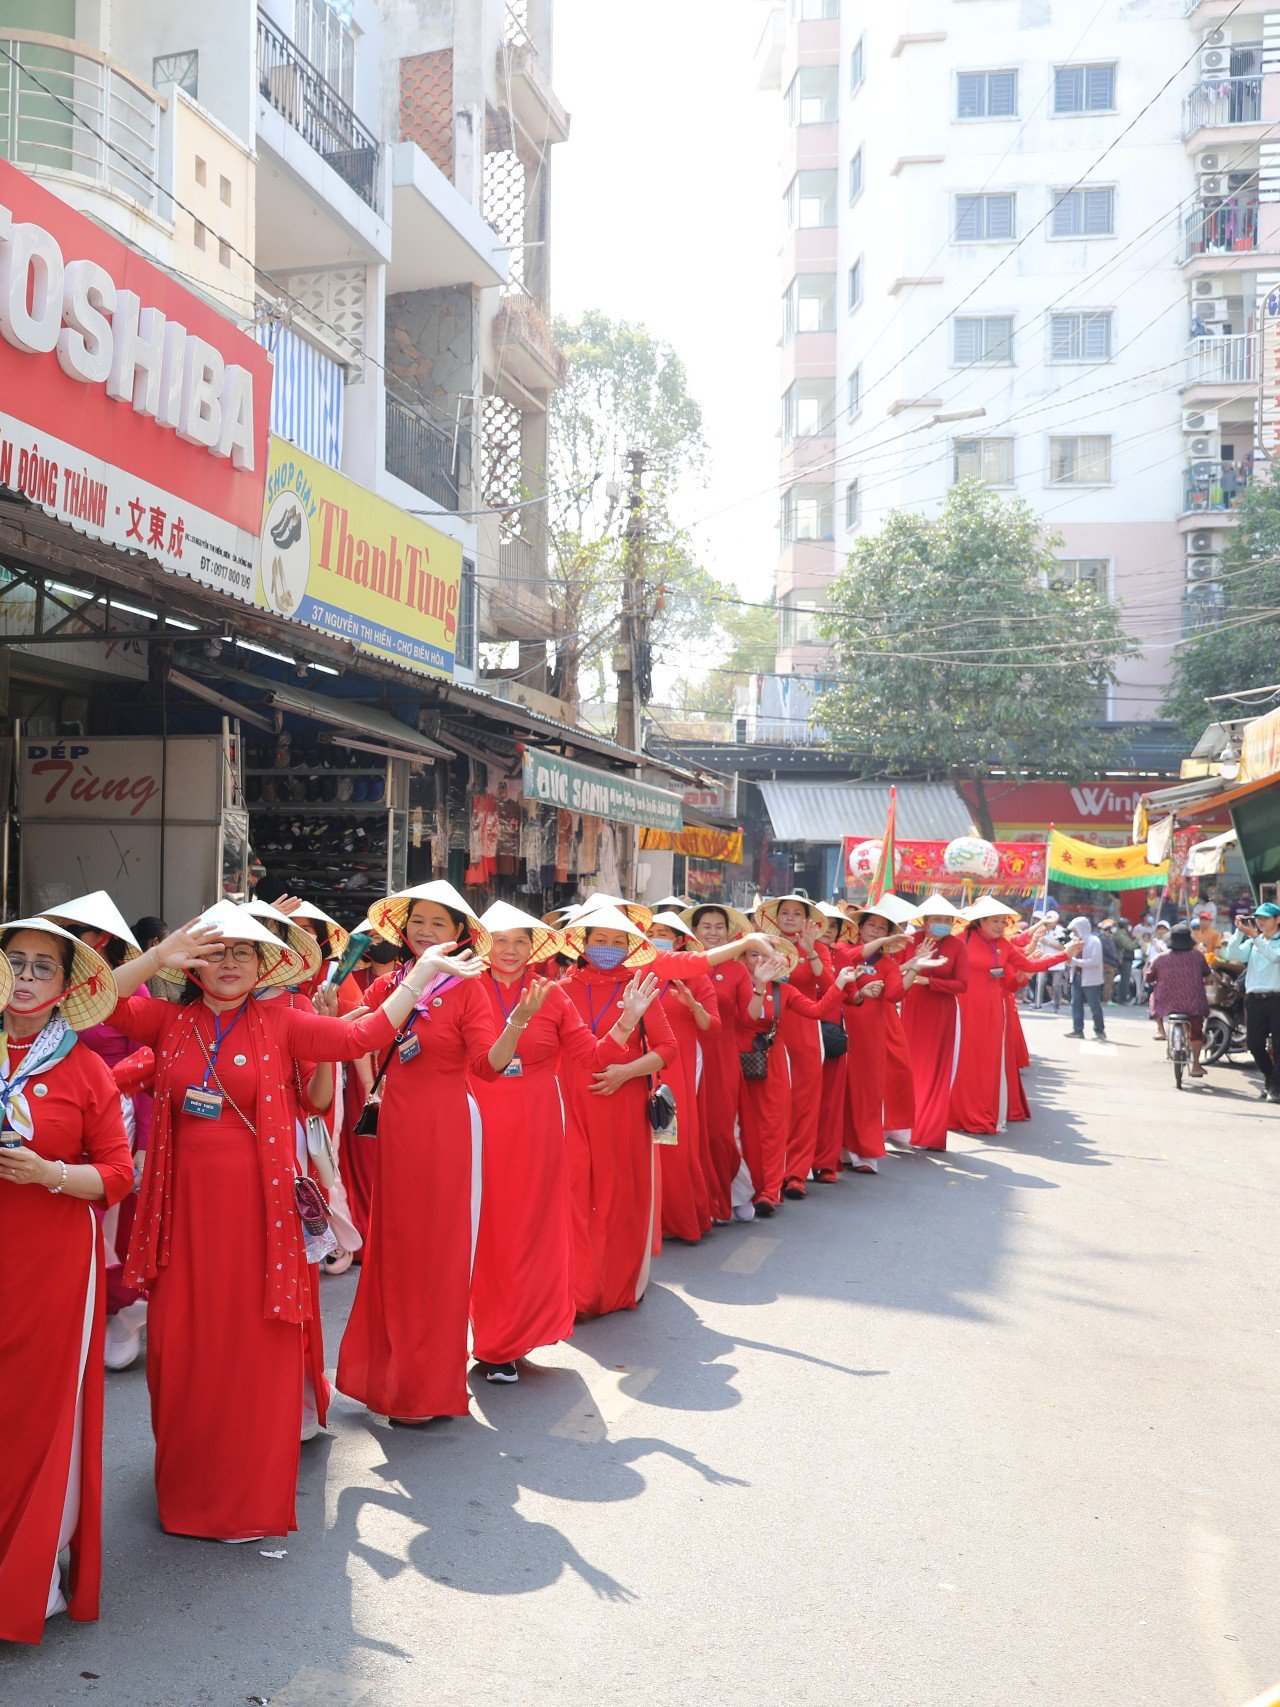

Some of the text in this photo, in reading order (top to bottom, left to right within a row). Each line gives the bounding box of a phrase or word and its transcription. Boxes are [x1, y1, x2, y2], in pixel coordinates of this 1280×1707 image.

[18, 444, 58, 508] ĐÔNG
[64, 467, 108, 528] THÀNH
[125, 497, 184, 559] 文東成
[268, 463, 294, 504] SHOP
[318, 498, 460, 642] Thanh Tùng
[311, 605, 324, 622] 37
[324, 612, 359, 636] NGUYỄN
[360, 625, 372, 643] THỊ
[396, 640, 413, 657] CHỢ
[413, 645, 429, 662] BIÊN
[430, 650, 445, 668] HÒA
[27, 741, 89, 760] DÉP
[31, 759, 160, 816] Tùng
[572, 778, 610, 815] SANH
